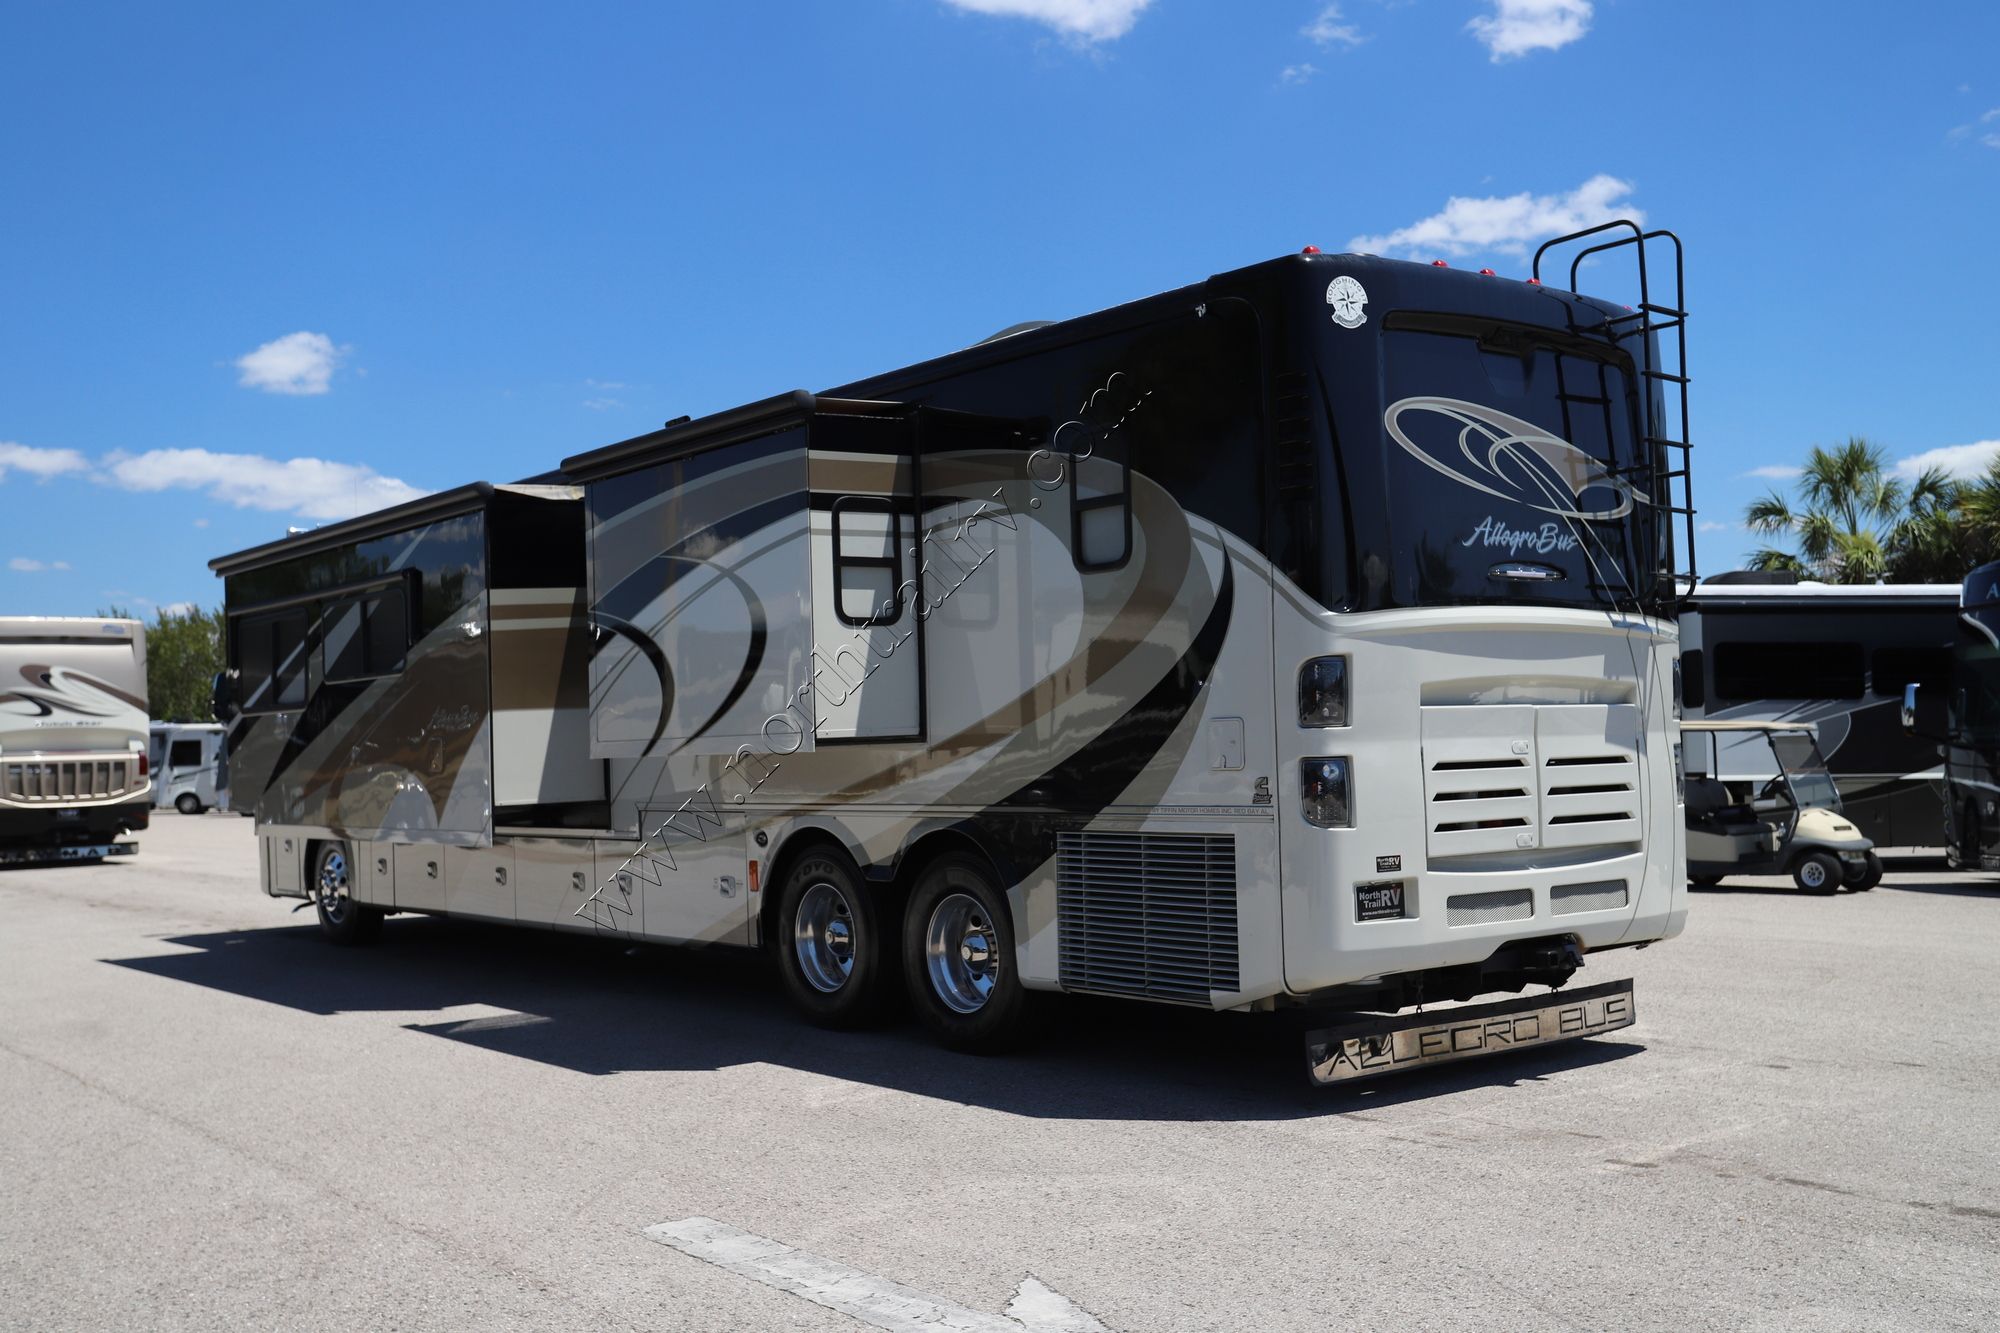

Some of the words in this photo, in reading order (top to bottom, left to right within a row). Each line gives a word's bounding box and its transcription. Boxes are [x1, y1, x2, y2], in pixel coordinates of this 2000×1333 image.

[1327, 277, 1363, 303] ROUGHING
[1359, 891, 1380, 900] North
[1380, 888, 1401, 907] RV
[1363, 900, 1381, 909] Trail
[1328, 1015, 1540, 1076] ALLEGRO
[1558, 998, 1627, 1034] BUS
